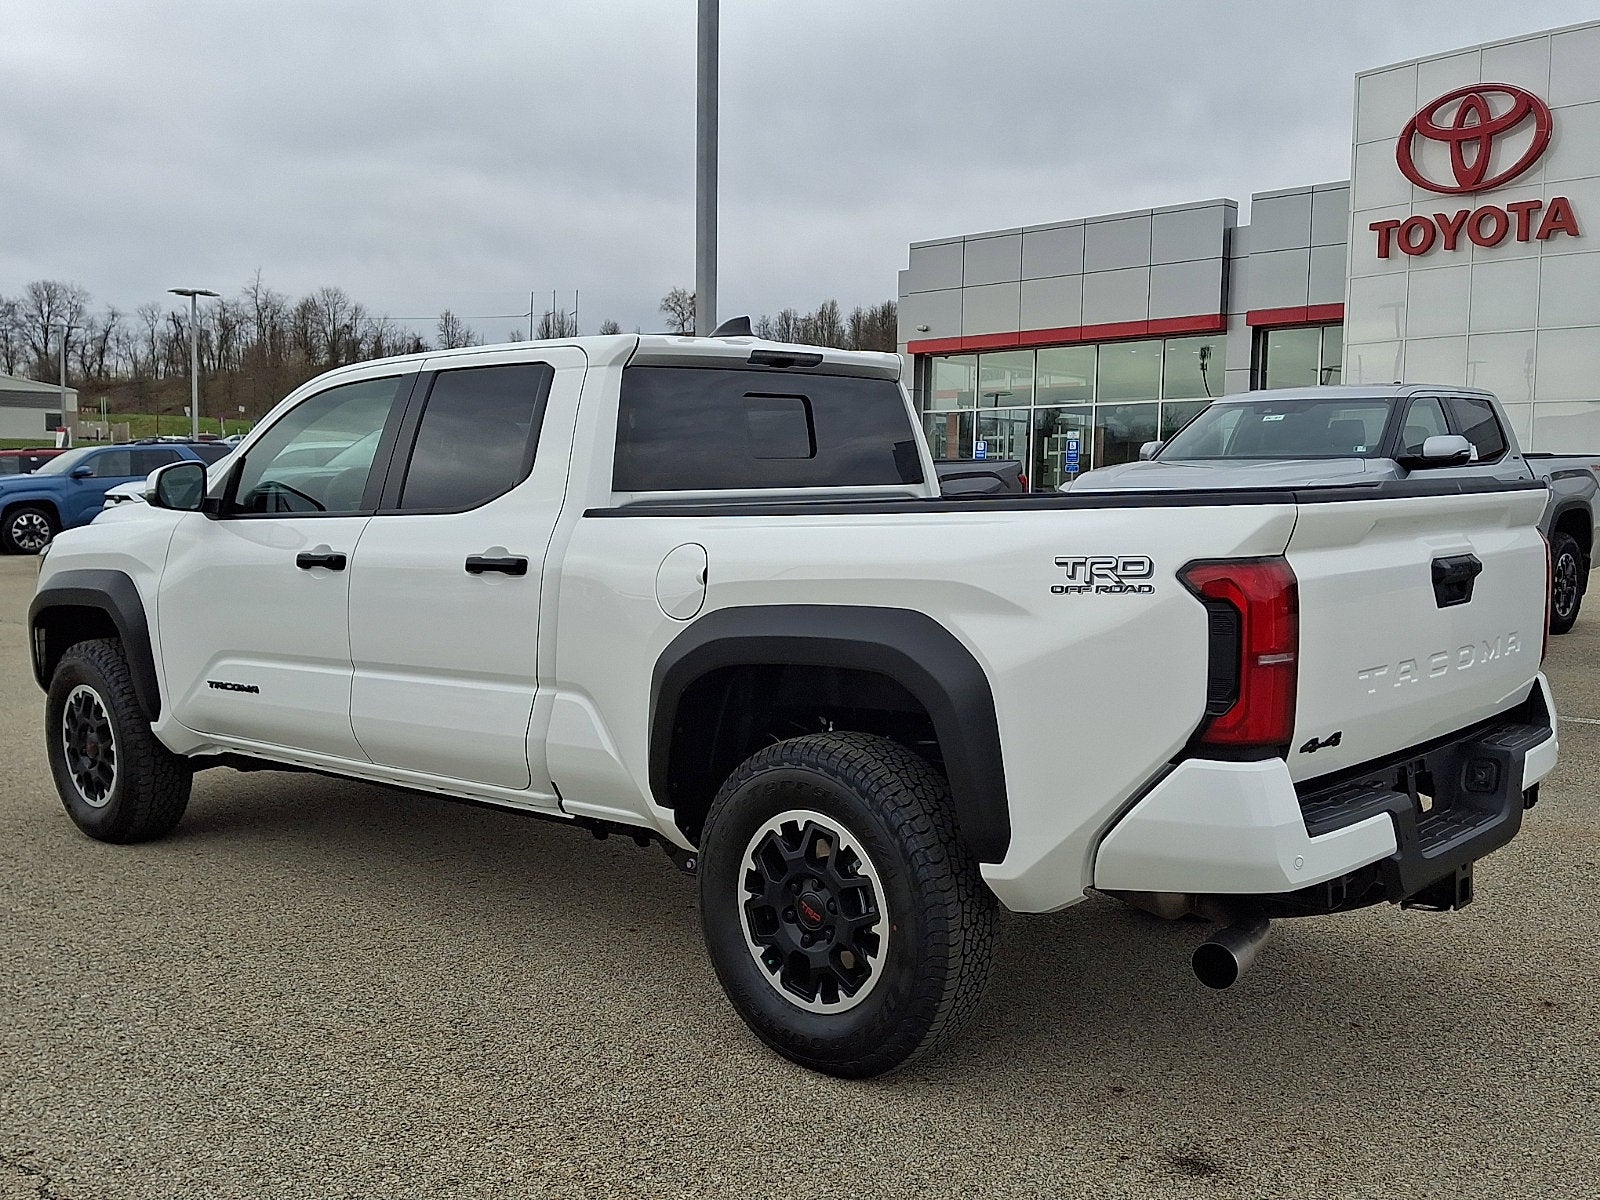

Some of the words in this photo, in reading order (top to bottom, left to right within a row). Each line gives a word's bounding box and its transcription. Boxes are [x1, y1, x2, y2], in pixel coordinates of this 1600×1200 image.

[1369, 196, 1580, 259] TOYOTA
[1054, 555, 1154, 585] TRD
[1050, 585, 1092, 595] OFF
[1094, 584, 1155, 595] ROAD
[1357, 631, 1521, 694] TACOMA
[206, 680, 260, 694] TACOMA
[801, 900, 822, 922] TRD
